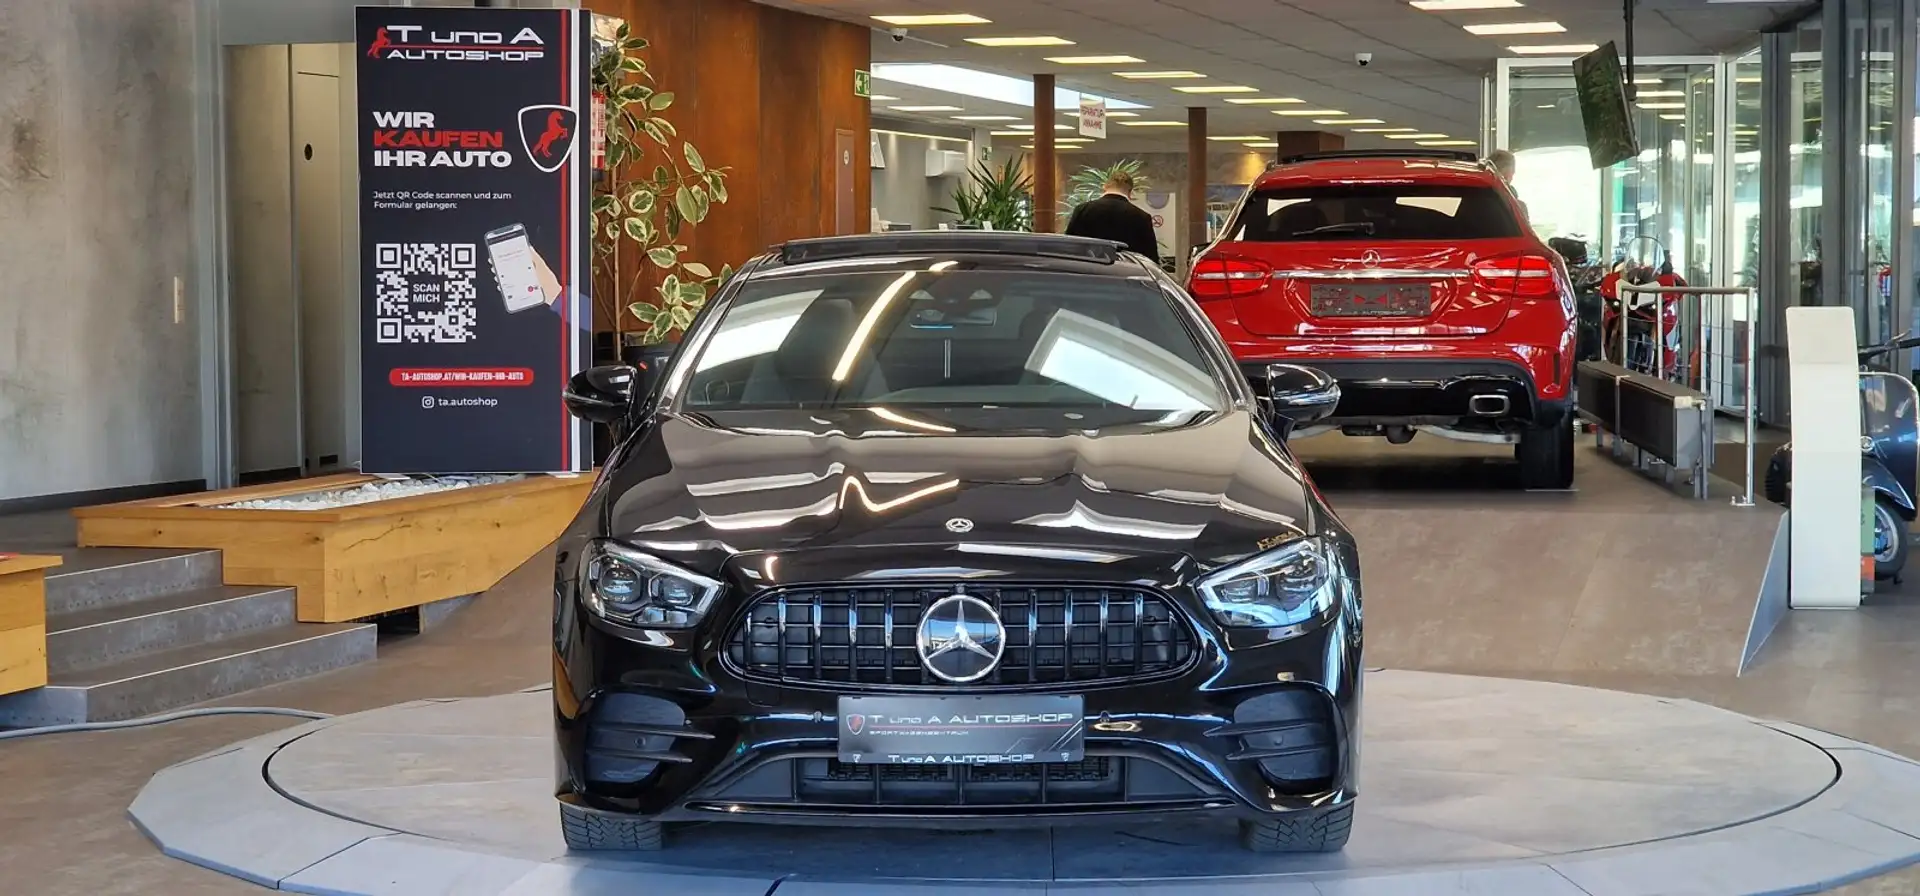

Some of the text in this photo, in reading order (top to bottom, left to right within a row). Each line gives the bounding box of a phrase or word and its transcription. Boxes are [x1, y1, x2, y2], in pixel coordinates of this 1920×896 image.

[386, 25, 422, 43] T
[510, 27, 545, 45] A
[386, 50, 545, 61] AUTOSHOP
[372, 111, 435, 129] WIR
[373, 131, 503, 148] KAUFEN
[374, 151, 513, 168] IHR AUTO
[374, 191, 512, 202] Jetzt QR Code scannen und zum
[374, 201, 458, 211] Formular gelangen:
[412, 283, 441, 293] SCAN
[412, 293, 441, 303] MICH
[438, 396, 498, 408] ta.autoshop
[868, 714, 884, 724] T
[928, 714, 942, 724] A
[949, 713, 1074, 724] AUTOSHOP
[888, 754, 900, 764] T
[923, 755, 937, 764] A
[942, 753, 1035, 764] AUTOSHOP
